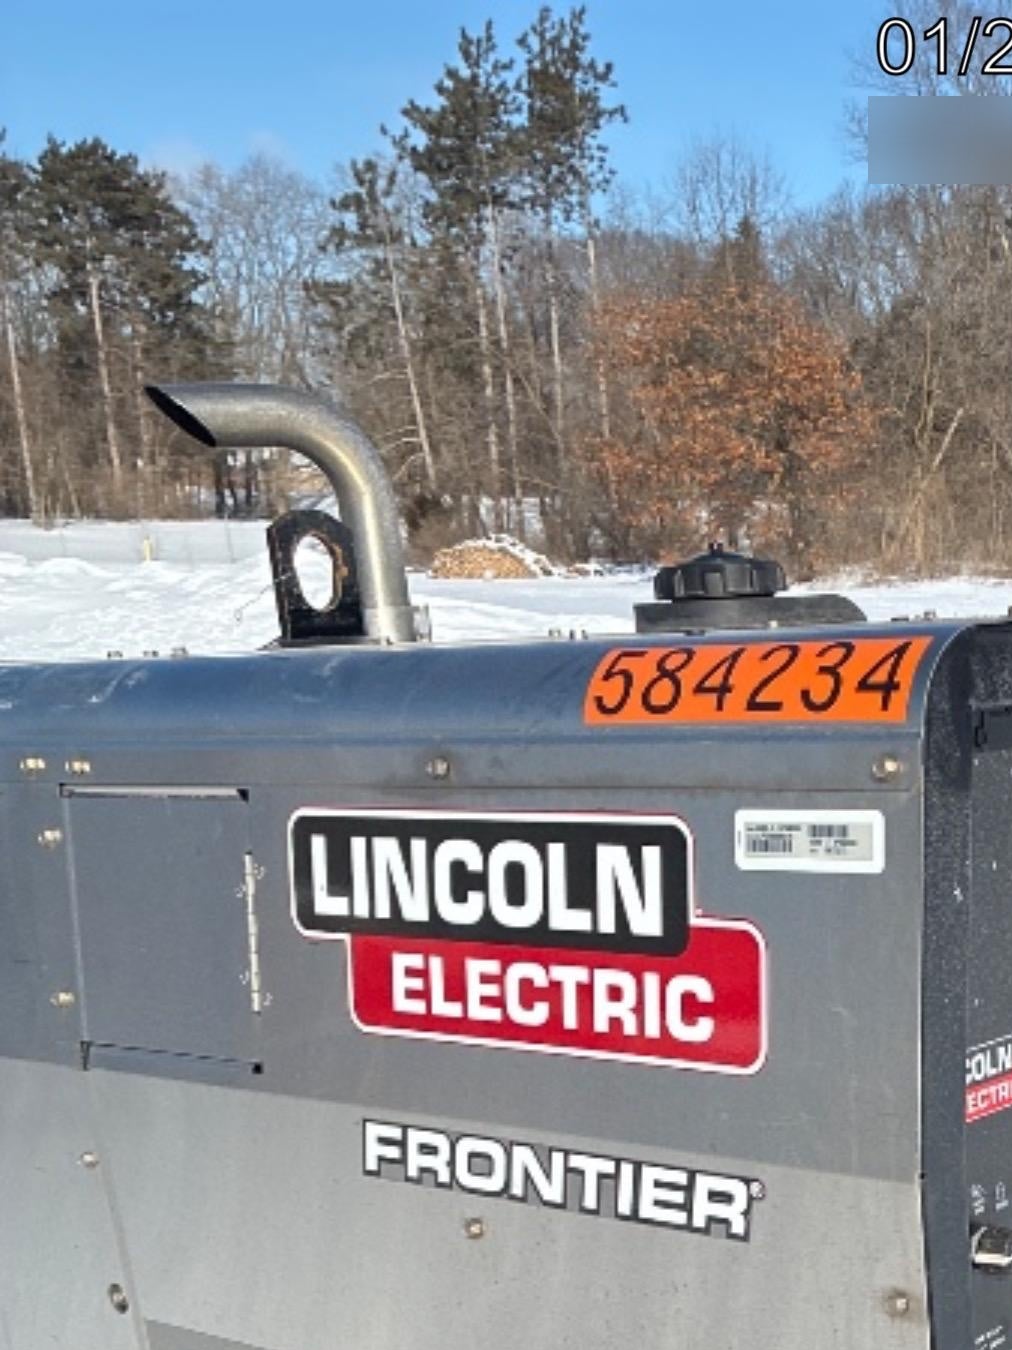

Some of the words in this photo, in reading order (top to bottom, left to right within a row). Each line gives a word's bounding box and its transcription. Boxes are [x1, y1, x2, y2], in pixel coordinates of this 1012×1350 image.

[594, 641, 912, 715] 584234
[310, 833, 664, 937] LINCOLN
[391, 952, 716, 1043] ELECTRIC
